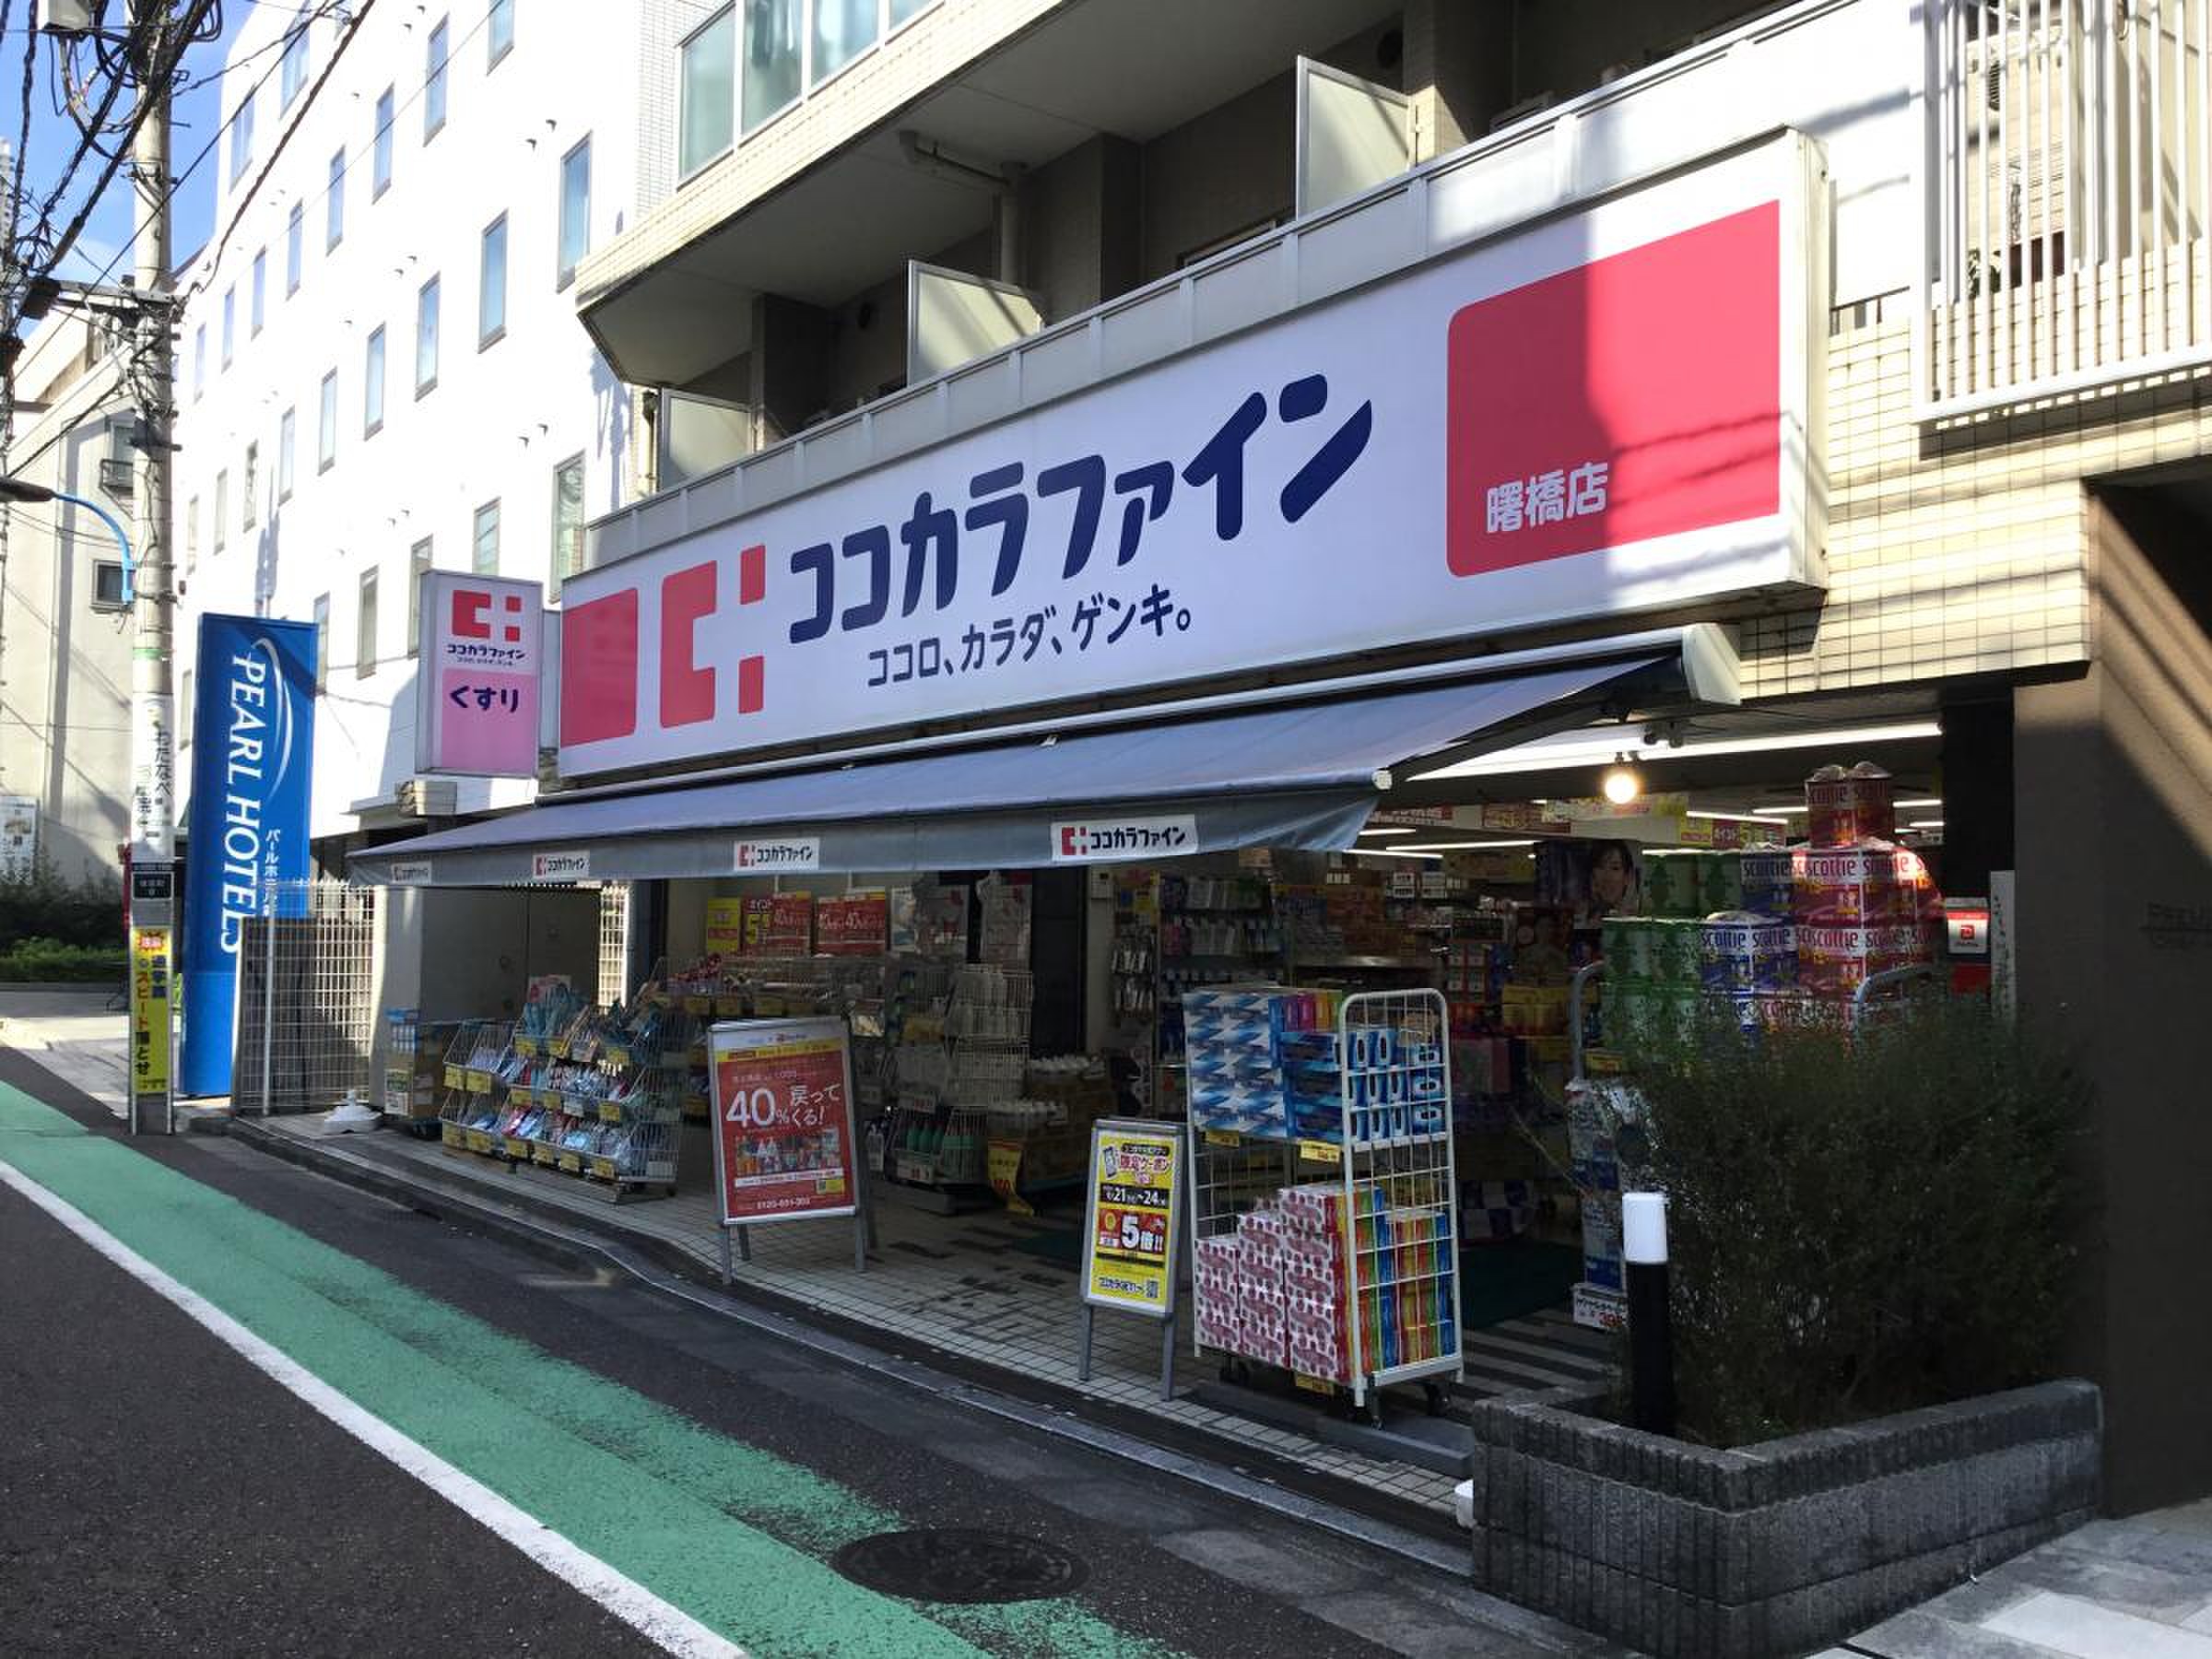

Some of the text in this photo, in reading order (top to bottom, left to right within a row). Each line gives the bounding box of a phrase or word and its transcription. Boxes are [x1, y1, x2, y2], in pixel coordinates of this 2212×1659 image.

[789, 373, 1372, 643] ココカラファイン
[1487, 462, 1607, 534] 曙橋店
[868, 583, 1191, 688] ココロ、カラダ、ゲンキ。
[447, 643, 526, 660] ココカラファイン
[450, 685, 519, 713] くすり
[226, 652, 267, 784] PEARL
[1090, 827, 1186, 850] ココカラファイン
[1806, 855, 1858, 877] scottie
[791, 1084, 841, 1107] 戻って
